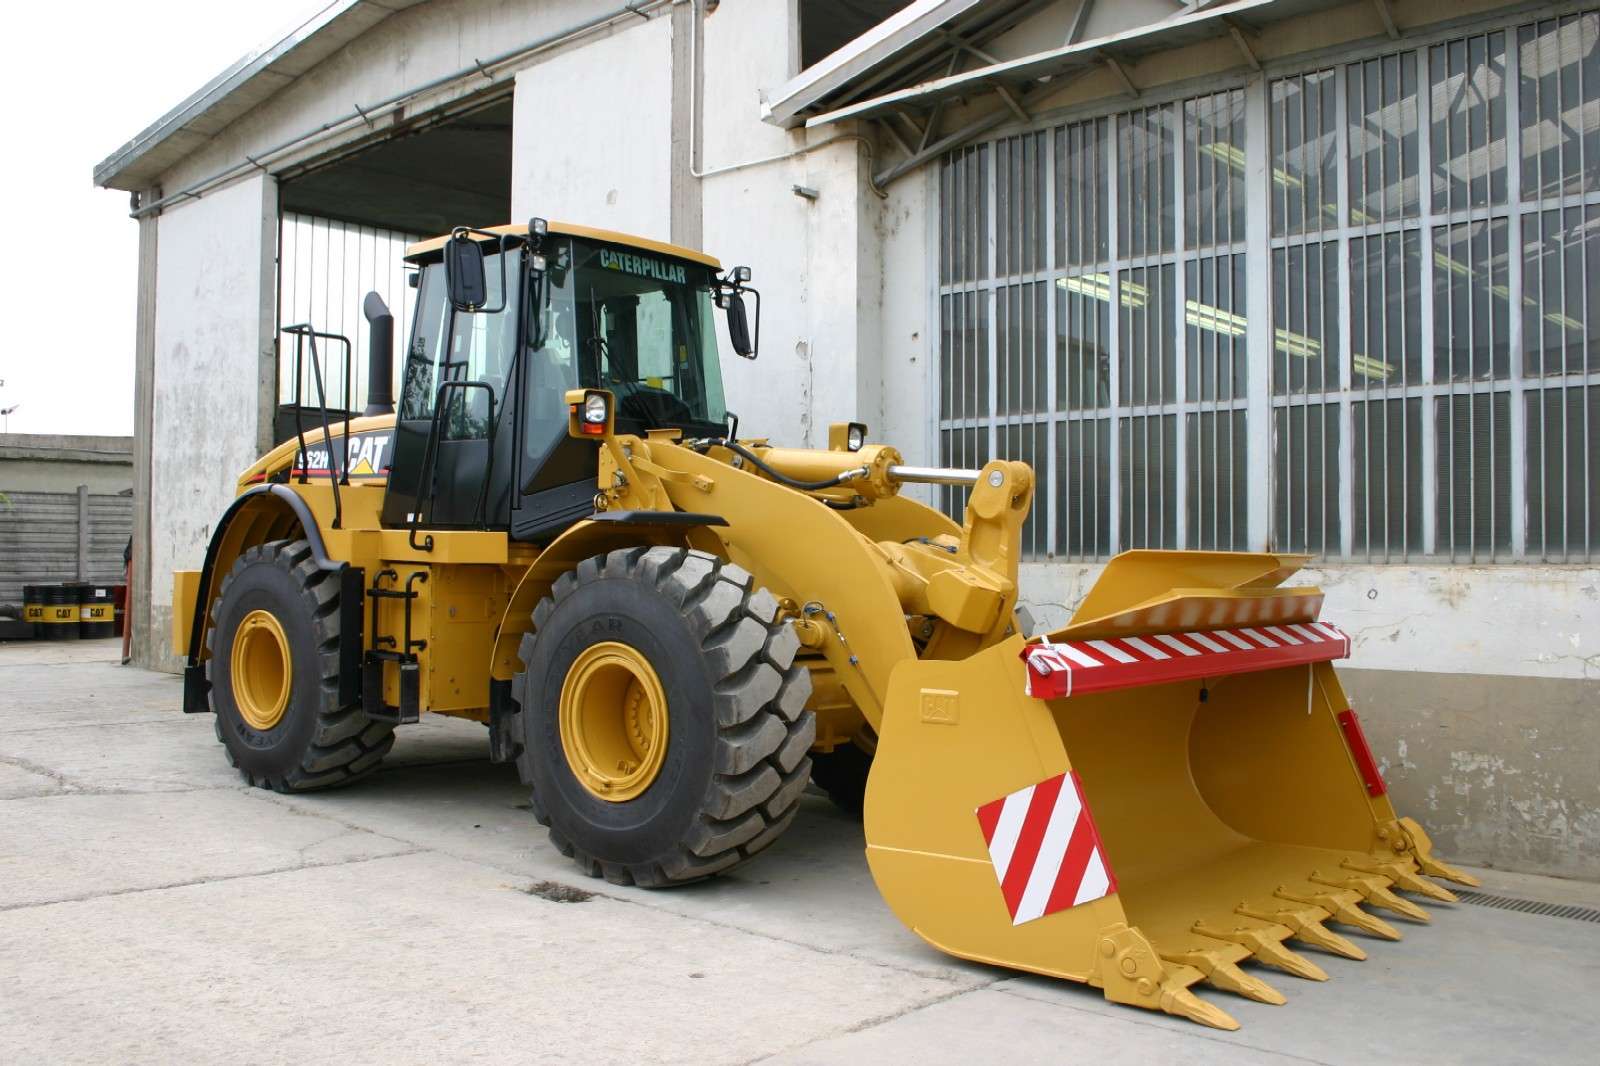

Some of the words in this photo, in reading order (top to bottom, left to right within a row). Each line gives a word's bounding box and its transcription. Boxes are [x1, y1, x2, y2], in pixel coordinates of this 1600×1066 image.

[600, 248, 687, 284] CATERPILLAR
[342, 436, 389, 474] CAT
[56, 608, 72, 618] CAT
[90, 607, 105, 617] CAT
[922, 695, 958, 721] CAT
